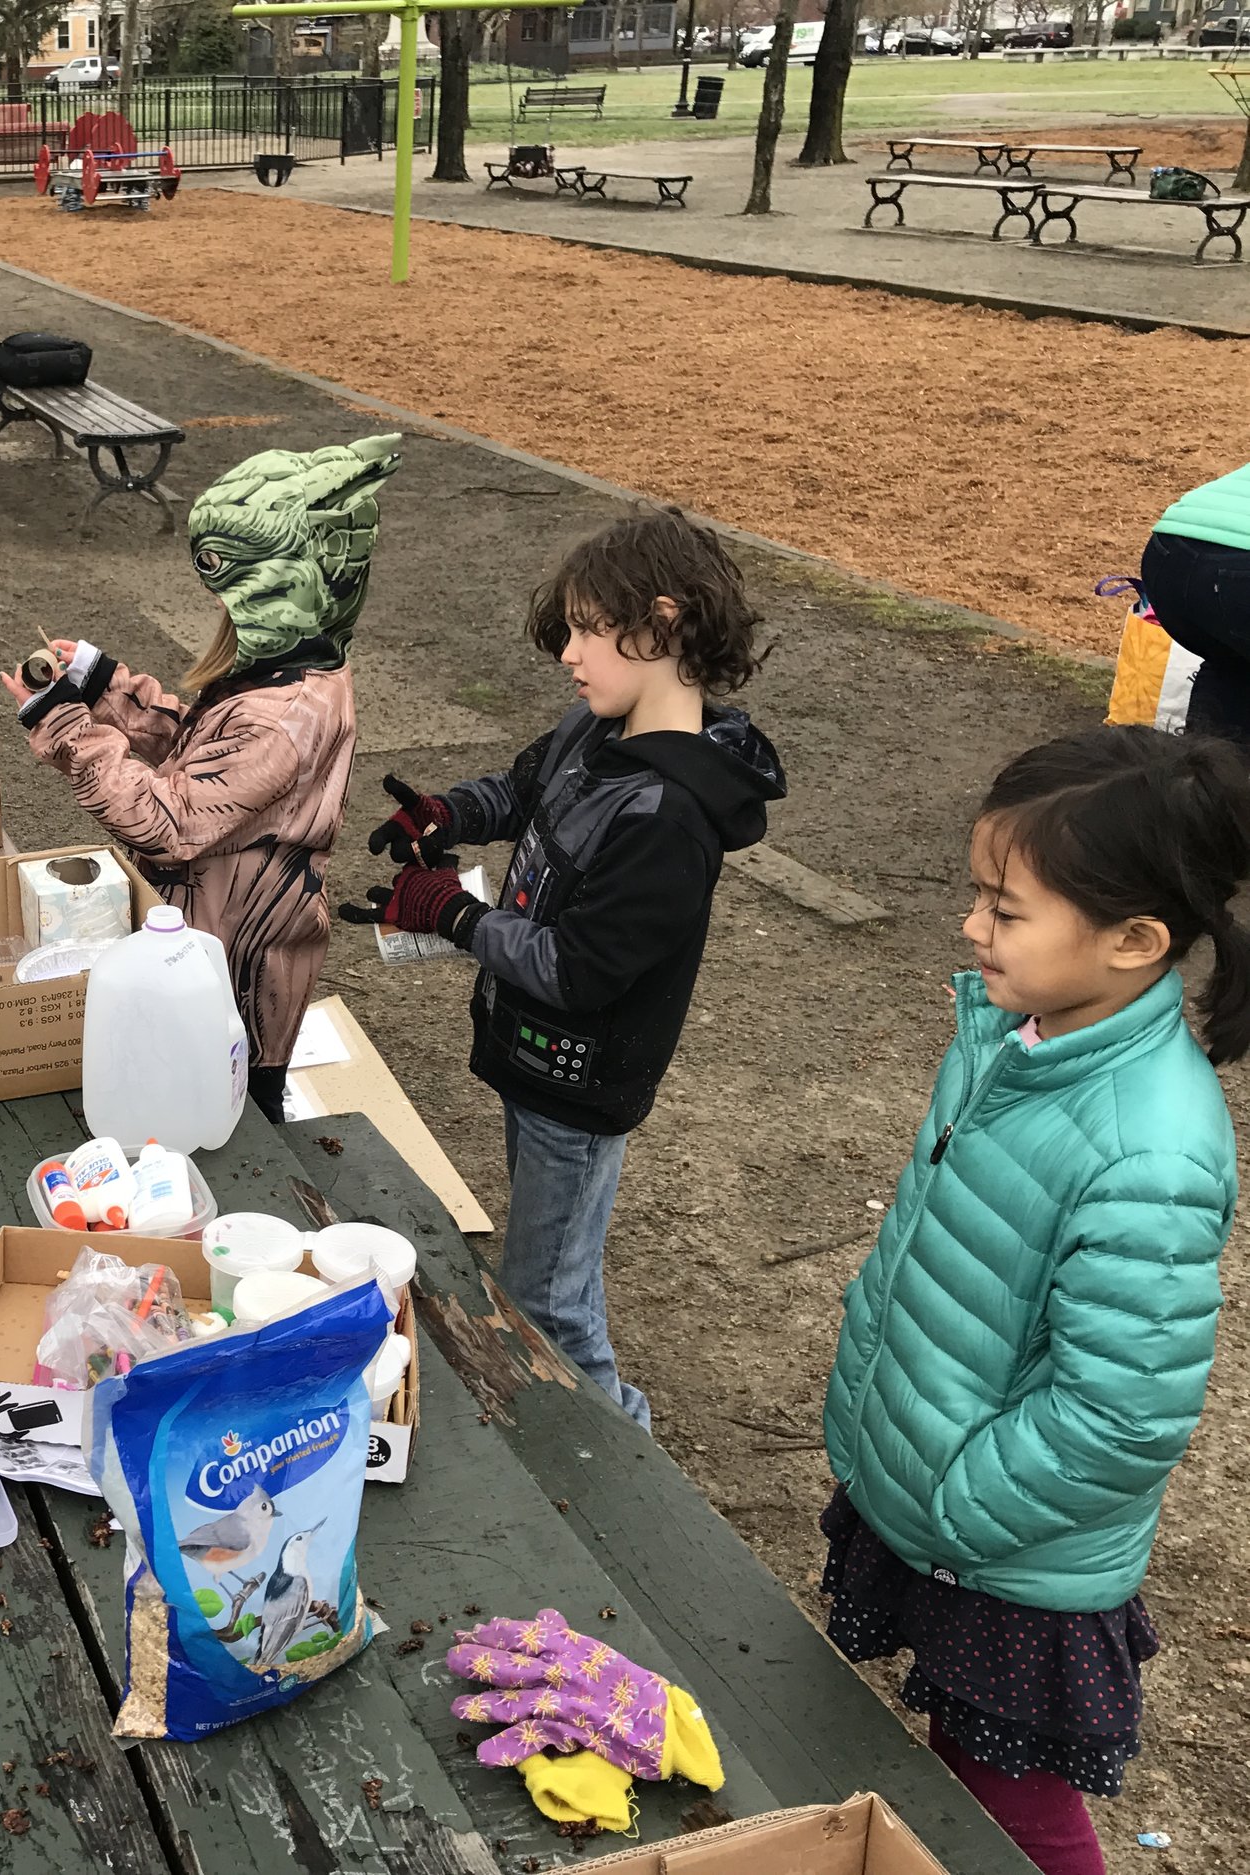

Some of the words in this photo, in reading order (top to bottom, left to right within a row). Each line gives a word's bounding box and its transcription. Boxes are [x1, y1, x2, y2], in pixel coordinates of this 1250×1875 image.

[19, 1006, 33, 1016] 8.2
[41, 1002, 60, 1012] KGS
[19, 1018, 33, 1027] 9.3
[41, 1014, 61, 1024] KGS
[27, 1043, 46, 1052] Road,
[48, 1039, 66, 1050] Perry
[26, 1062, 52, 1073] Harbor
[54, 1060, 69, 1068] 925
[1, 1067, 24, 1076] Plaza,
[198, 1412, 340, 1498] Companion
[196, 1722, 210, 1731] NET
